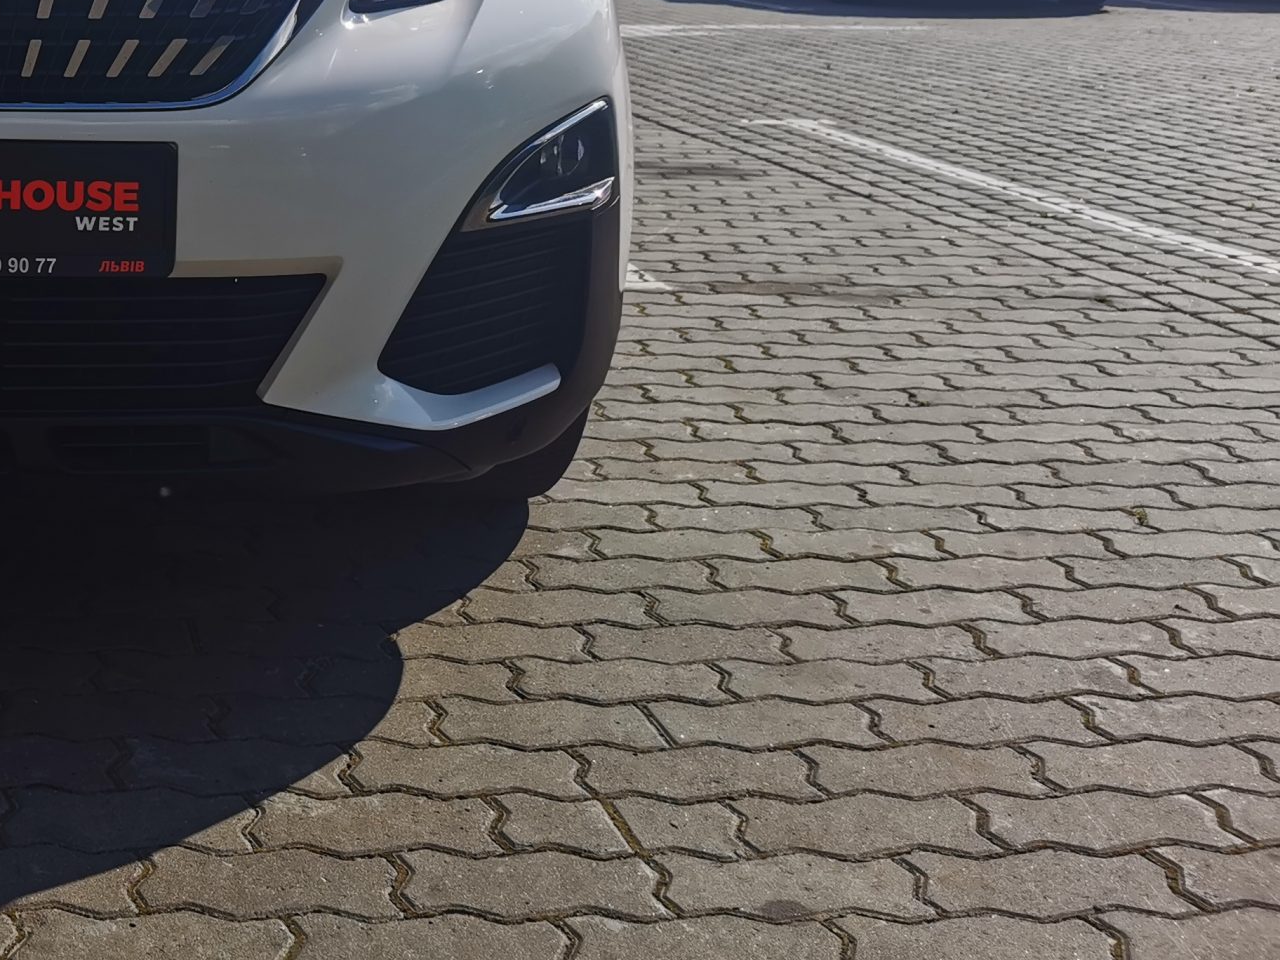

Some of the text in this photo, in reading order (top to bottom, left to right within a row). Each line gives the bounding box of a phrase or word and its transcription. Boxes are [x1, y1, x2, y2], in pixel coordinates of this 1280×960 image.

[75, 215, 139, 233] WEST
[8, 257, 30, 274] 90
[35, 257, 57, 274] 77
[98, 259, 145, 274] ЛЬВІВ
